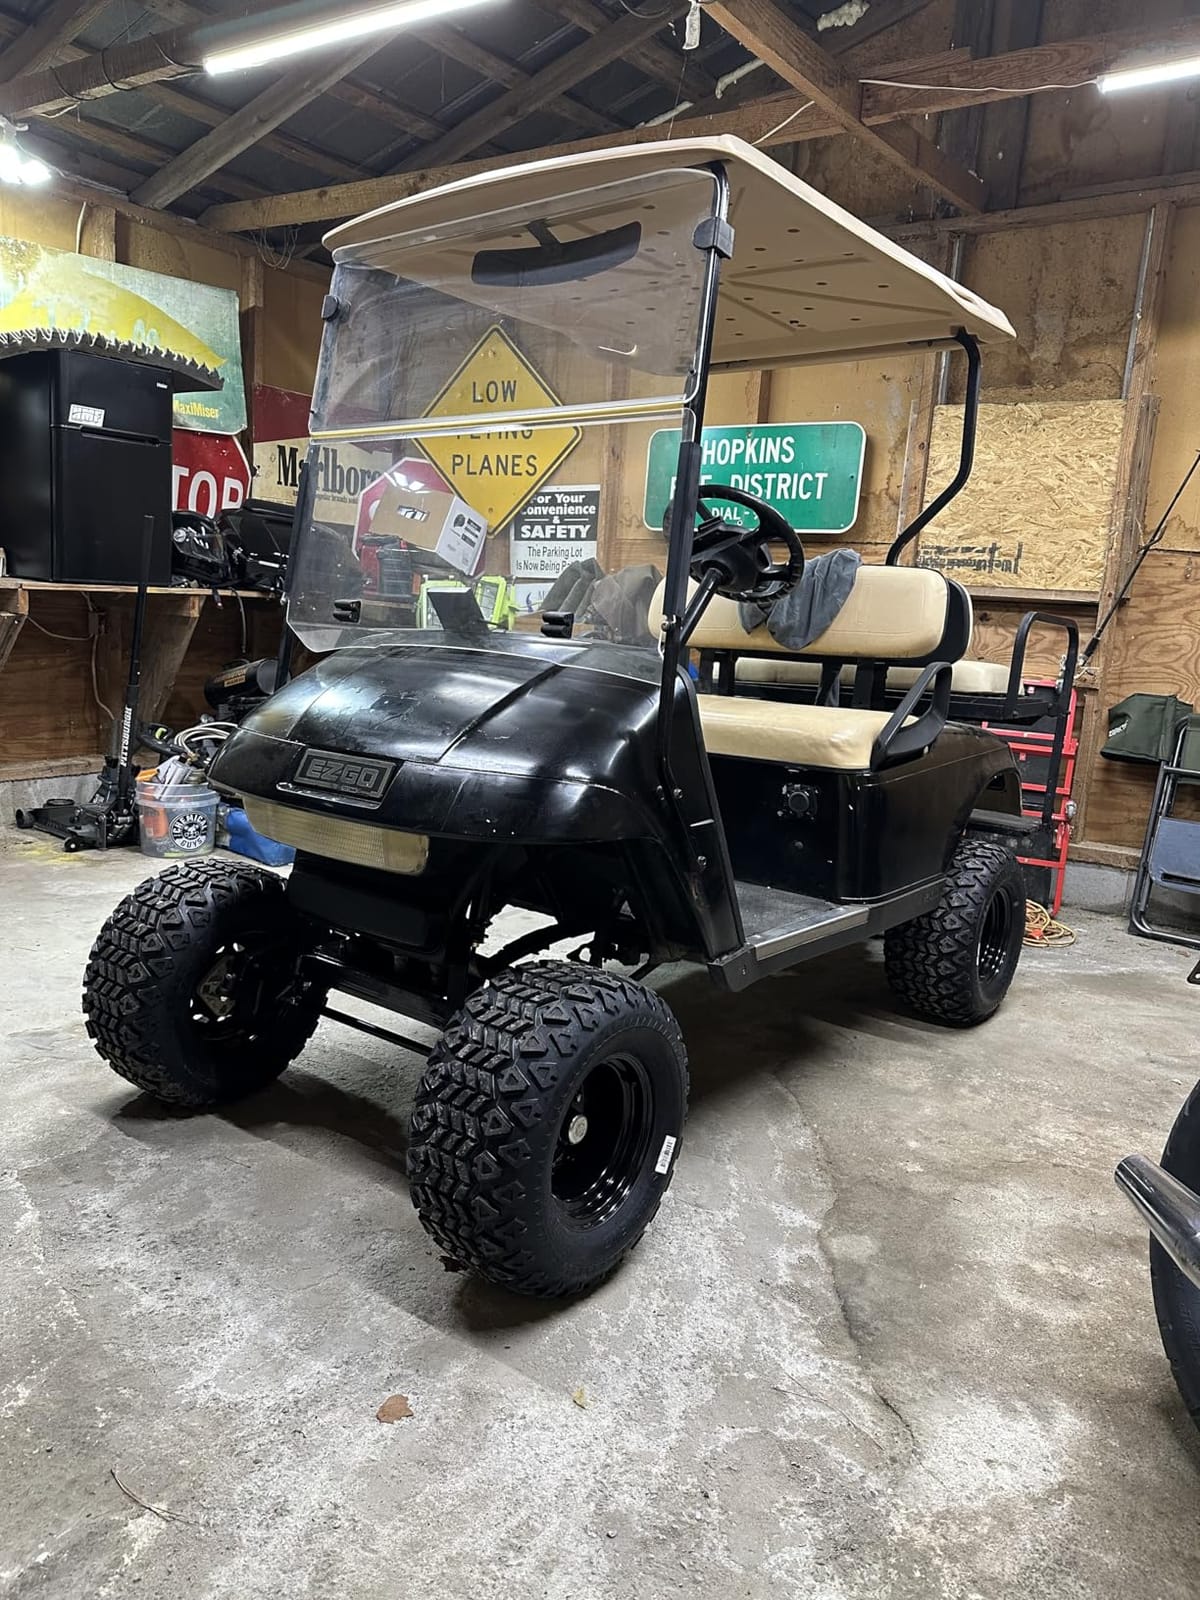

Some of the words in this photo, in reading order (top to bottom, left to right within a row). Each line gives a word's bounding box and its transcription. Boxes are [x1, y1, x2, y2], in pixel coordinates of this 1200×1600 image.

[472, 380, 517, 403] LOW
[702, 436, 795, 465] HOPKINS
[451, 454, 538, 477] PLANES
[173, 464, 244, 519] TOP
[730, 472, 828, 500] DISTRICT
[530, 494, 552, 504] or
[554, 493, 586, 504] Your
[522, 504, 597, 515] onvenience
[552, 516, 561, 524] &
[520, 524, 592, 539] SAFETY
[527, 546, 541, 557] The
[542, 545, 570, 560] Parking
[570, 546, 583, 557] Lot
[516, 560, 522, 570] Is
[523, 560, 539, 571] Now
[540, 560, 561, 574] Being
[120, 704, 132, 767] PITTSBURGH
[305, 758, 380, 789] EZGO
[180, 836, 203, 848] GUYS
